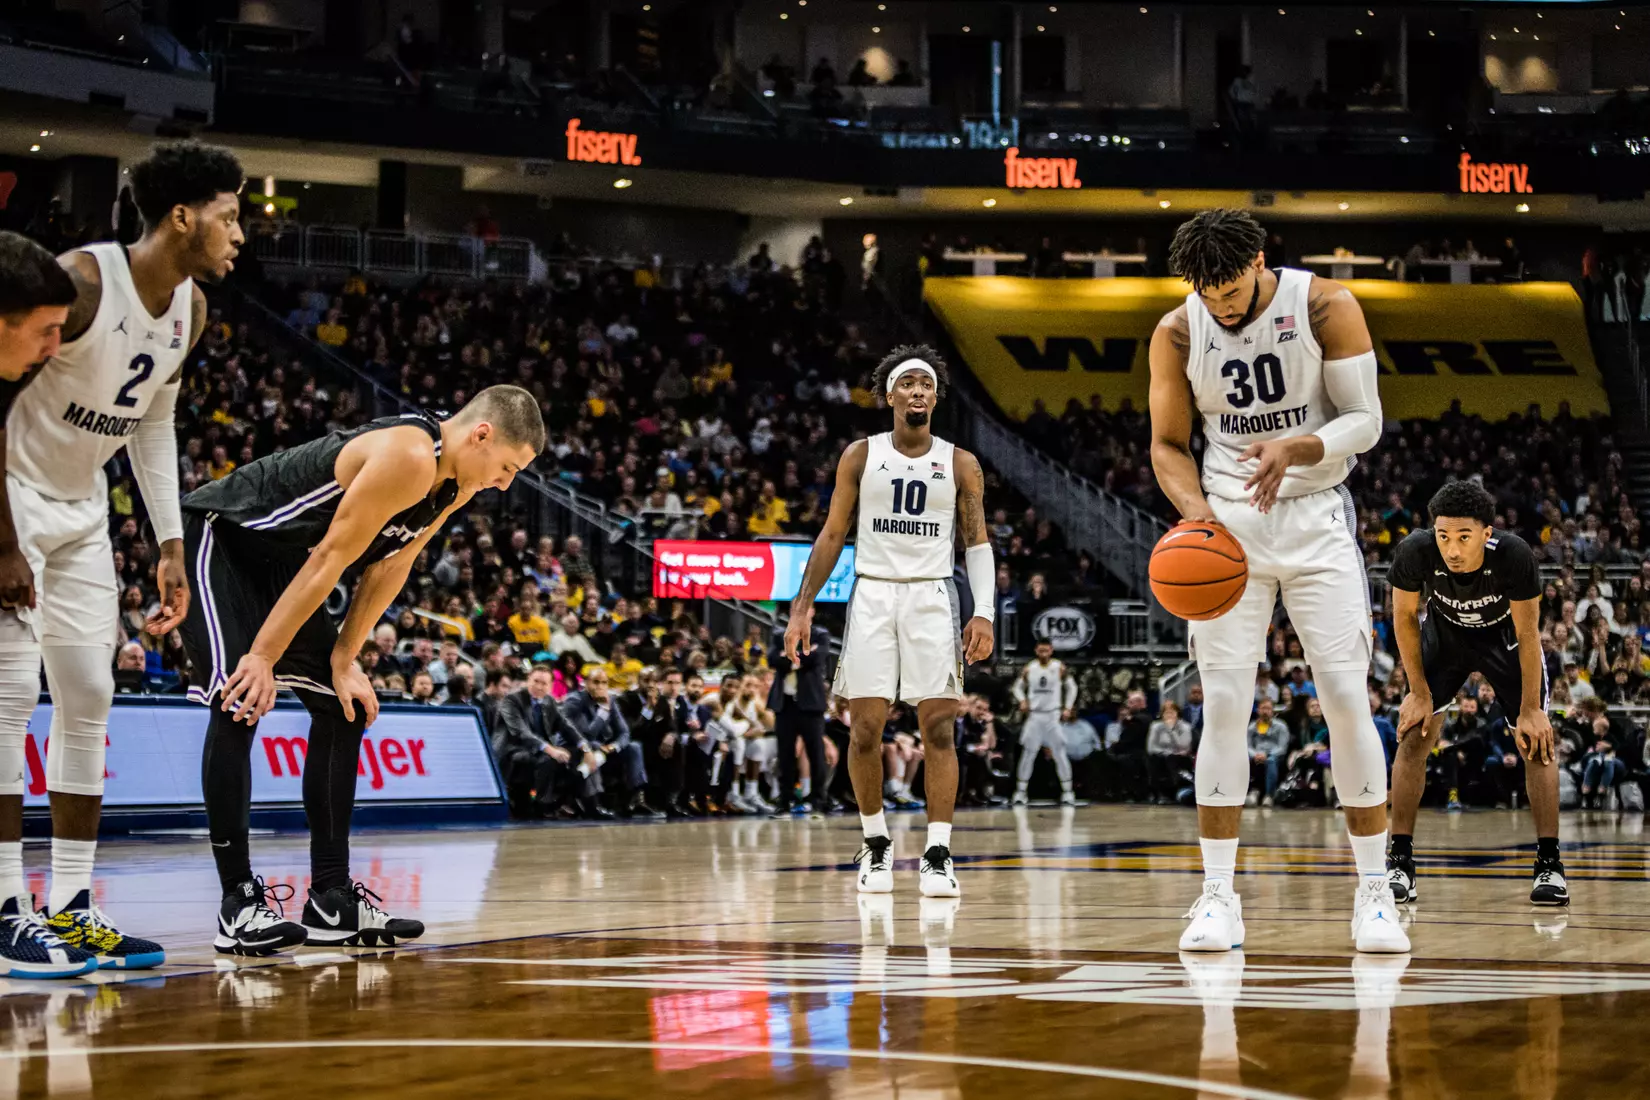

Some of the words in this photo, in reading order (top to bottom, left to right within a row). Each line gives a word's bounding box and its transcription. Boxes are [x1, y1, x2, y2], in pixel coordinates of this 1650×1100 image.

[565, 118, 642, 166] fiserv.
[1004, 147, 1082, 189] fiserv.
[1458, 152, 1533, 193] fiserv.
[996, 335, 1150, 373] W
[1377, 339, 1579, 376] RE
[113, 353, 155, 408] 2
[1221, 352, 1287, 409] 30
[891, 478, 928, 516] 10
[872, 518, 940, 537] MARQUETTE
[1046, 616, 1081, 635] FOX
[261, 736, 425, 791] mjer
